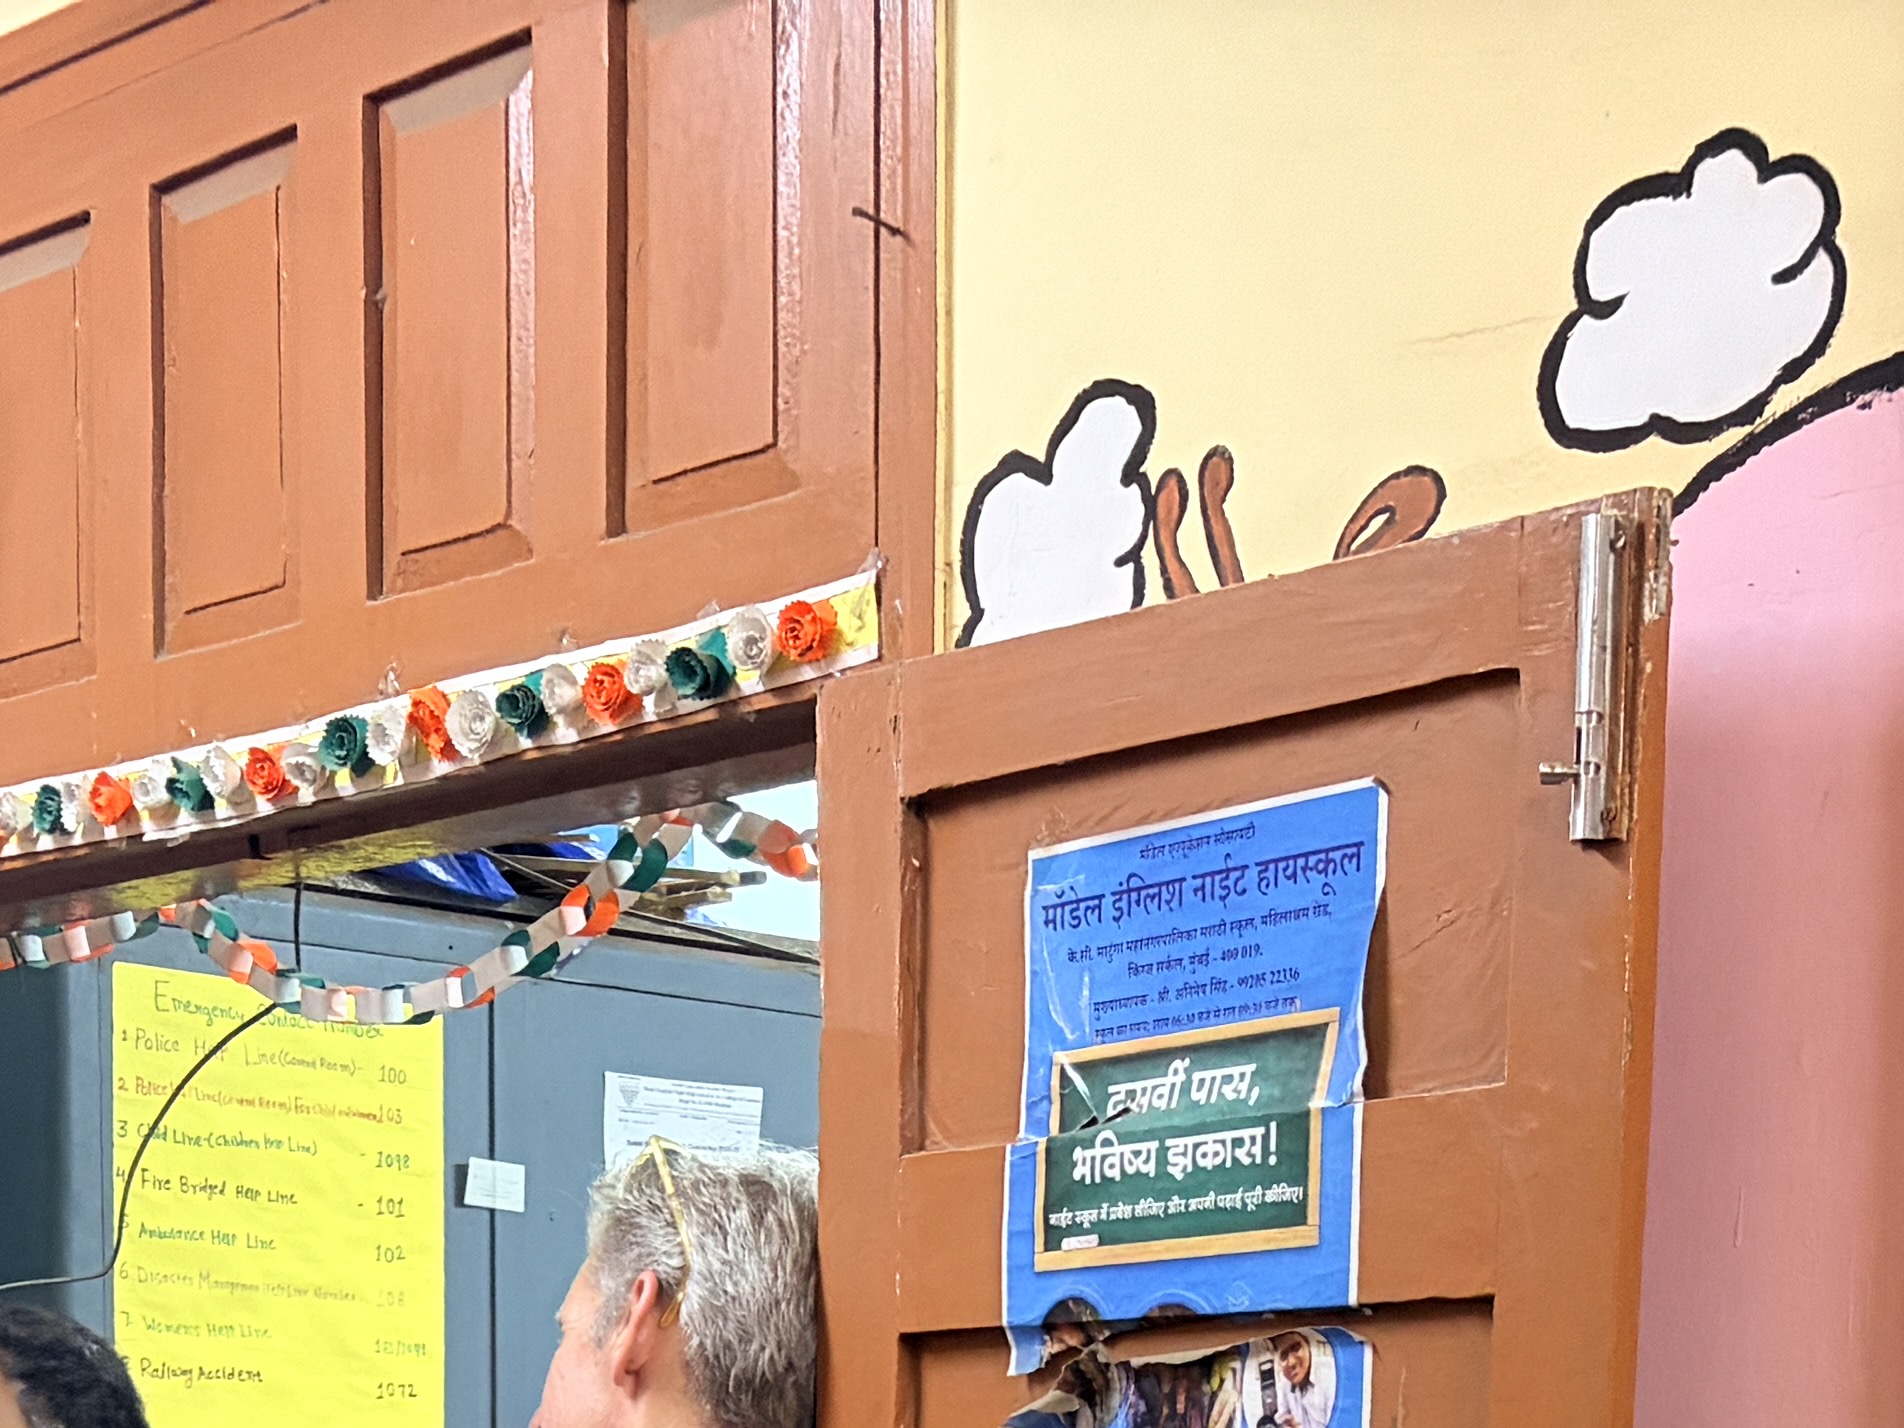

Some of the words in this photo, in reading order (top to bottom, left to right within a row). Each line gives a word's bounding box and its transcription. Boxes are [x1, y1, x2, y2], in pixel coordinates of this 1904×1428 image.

[1042, 886, 1106, 931] मॉडेल
[1111, 872, 1187, 929] इंग्लिश
[1192, 853, 1249, 909] नाईट
[1255, 841, 1365, 896] हायस्कूल
[1200, 918, 1227, 939] मराठी
[155, 980, 245, 1026] Emergency
[121, 1029, 127, 1041] 1
[135, 1027, 180, 1052] Police
[378, 1065, 407, 1084] 100
[117, 1077, 129, 1092] 2
[1191, 1063, 1260, 1106] पास,
[116, 1120, 128, 1137] 3
[1072, 1129, 1159, 1185] भविष्य
[1165, 1121, 1278, 1180] झकास!
[141, 1168, 171, 1190] Fire
[180, 1175, 226, 1201] Bridged
[267, 1190, 298, 1204] Line
[376, 1196, 405, 1218] 101
[246, 1232, 277, 1250] Line
[375, 1244, 406, 1263] 102
[119, 1262, 128, 1279] 6
[121, 1311, 132, 1327] 7
[240, 1325, 272, 1339] Line
[376, 1382, 418, 1399] 1072
